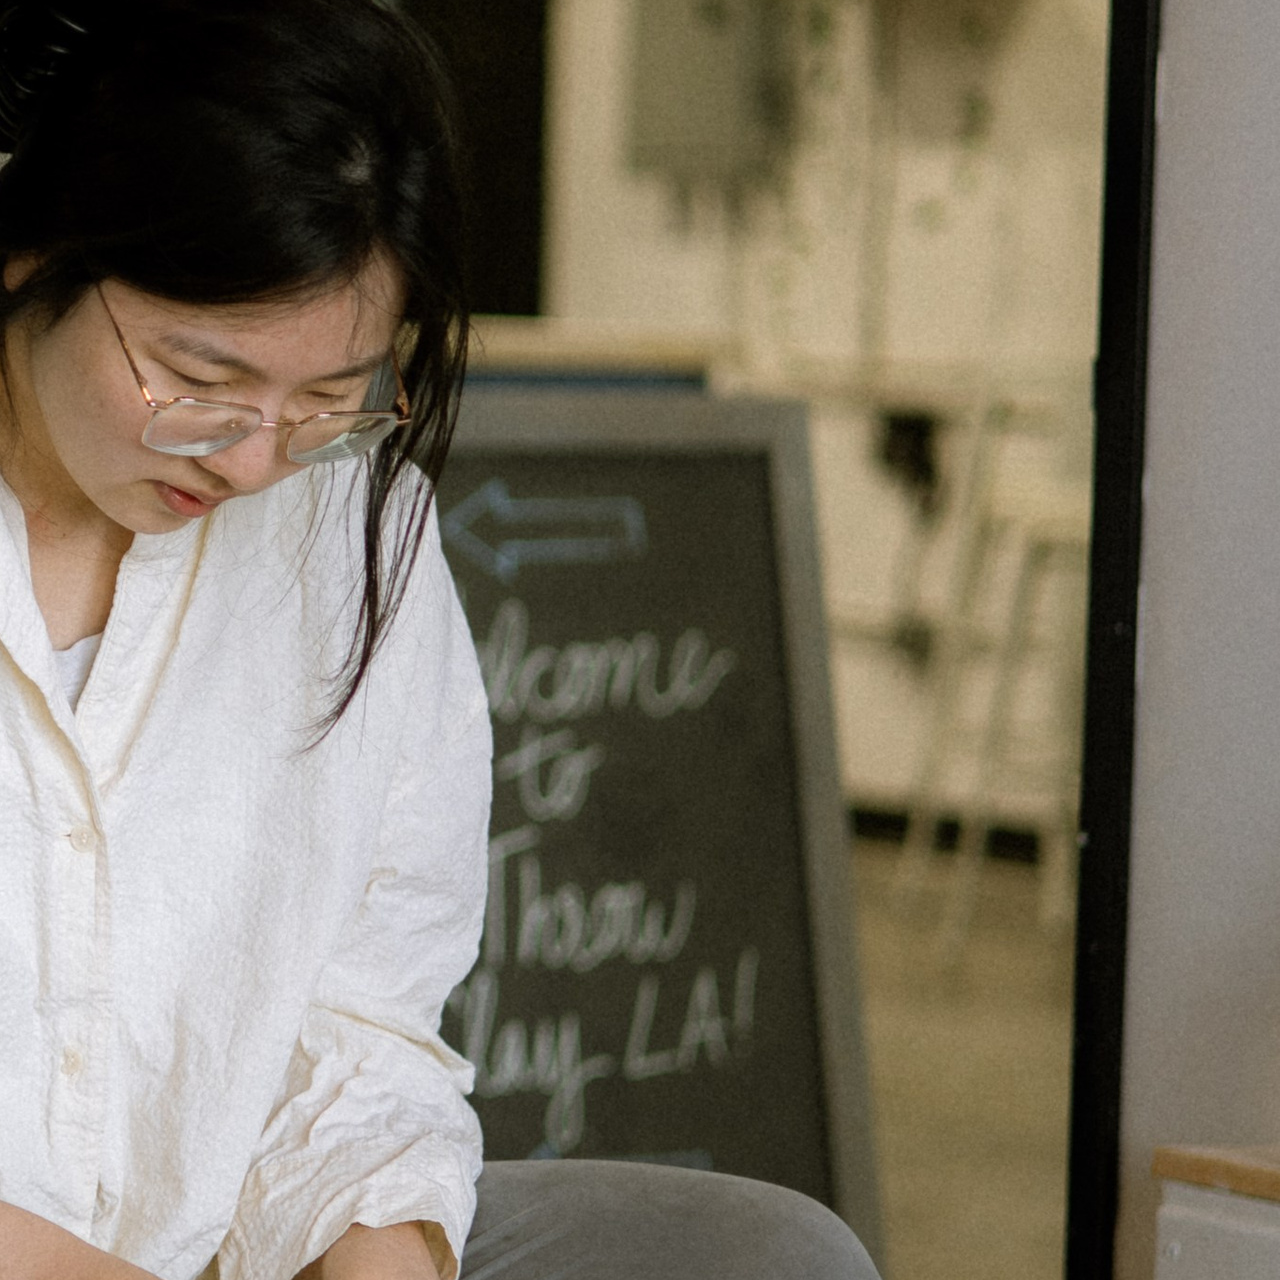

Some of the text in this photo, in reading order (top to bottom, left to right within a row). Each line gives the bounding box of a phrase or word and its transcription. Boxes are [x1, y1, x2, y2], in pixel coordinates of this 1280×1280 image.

[476, 598, 738, 721] lcome
[496, 726, 606, 821] to
[447, 973, 616, 1151] lay
